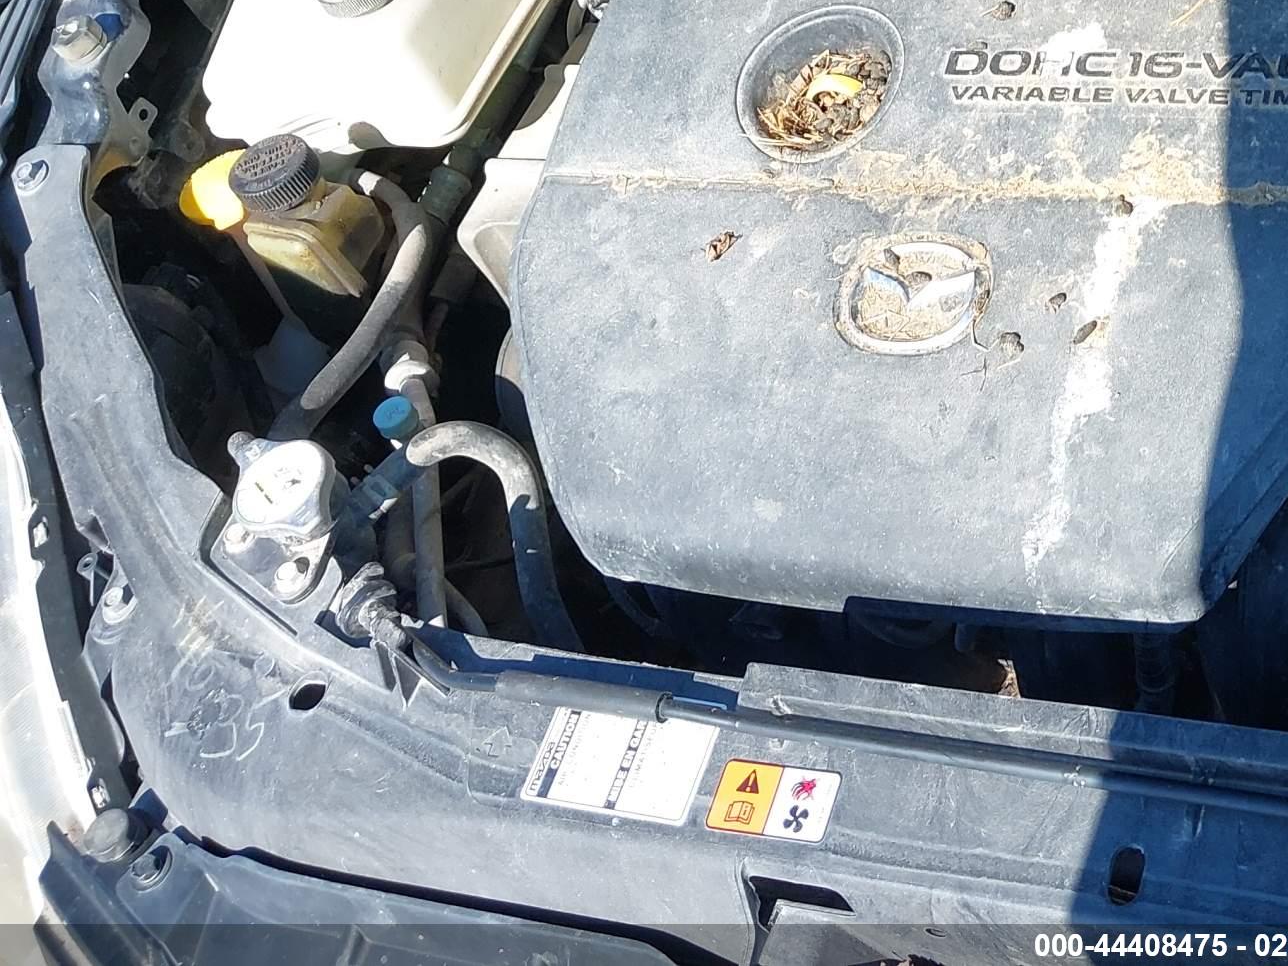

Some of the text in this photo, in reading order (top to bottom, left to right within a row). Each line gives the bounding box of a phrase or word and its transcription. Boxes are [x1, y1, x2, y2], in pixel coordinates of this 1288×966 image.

[951, 85, 1115, 103] VARIABLE
[1125, 87, 1229, 105] VALVE
[550, 713, 580, 770] CAUTION
[621, 750, 637, 768] EN
